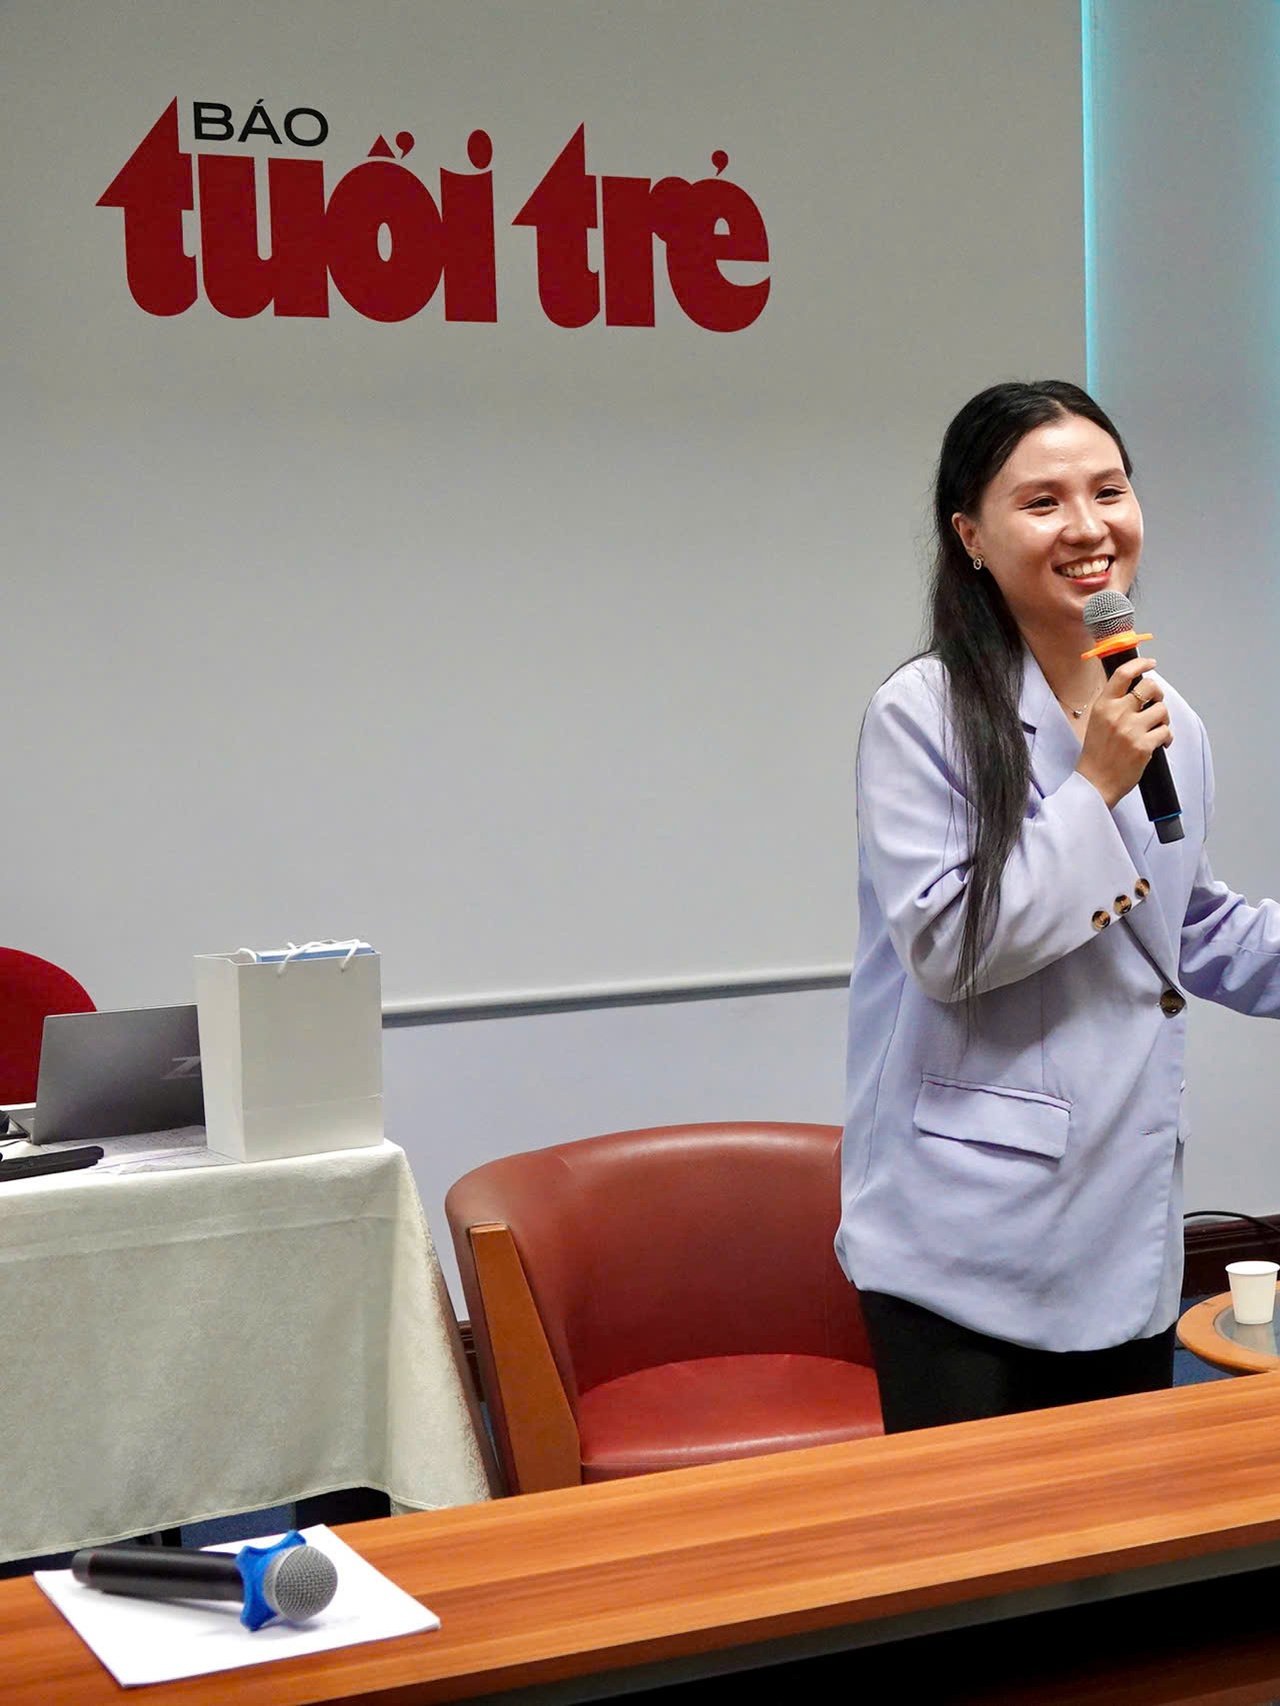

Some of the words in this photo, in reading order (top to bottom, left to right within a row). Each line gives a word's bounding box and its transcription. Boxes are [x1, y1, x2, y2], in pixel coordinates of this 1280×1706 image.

[193, 99, 328, 146] BÁO
[95, 95, 498, 323] tuổi
[511, 121, 771, 333] trẻ
